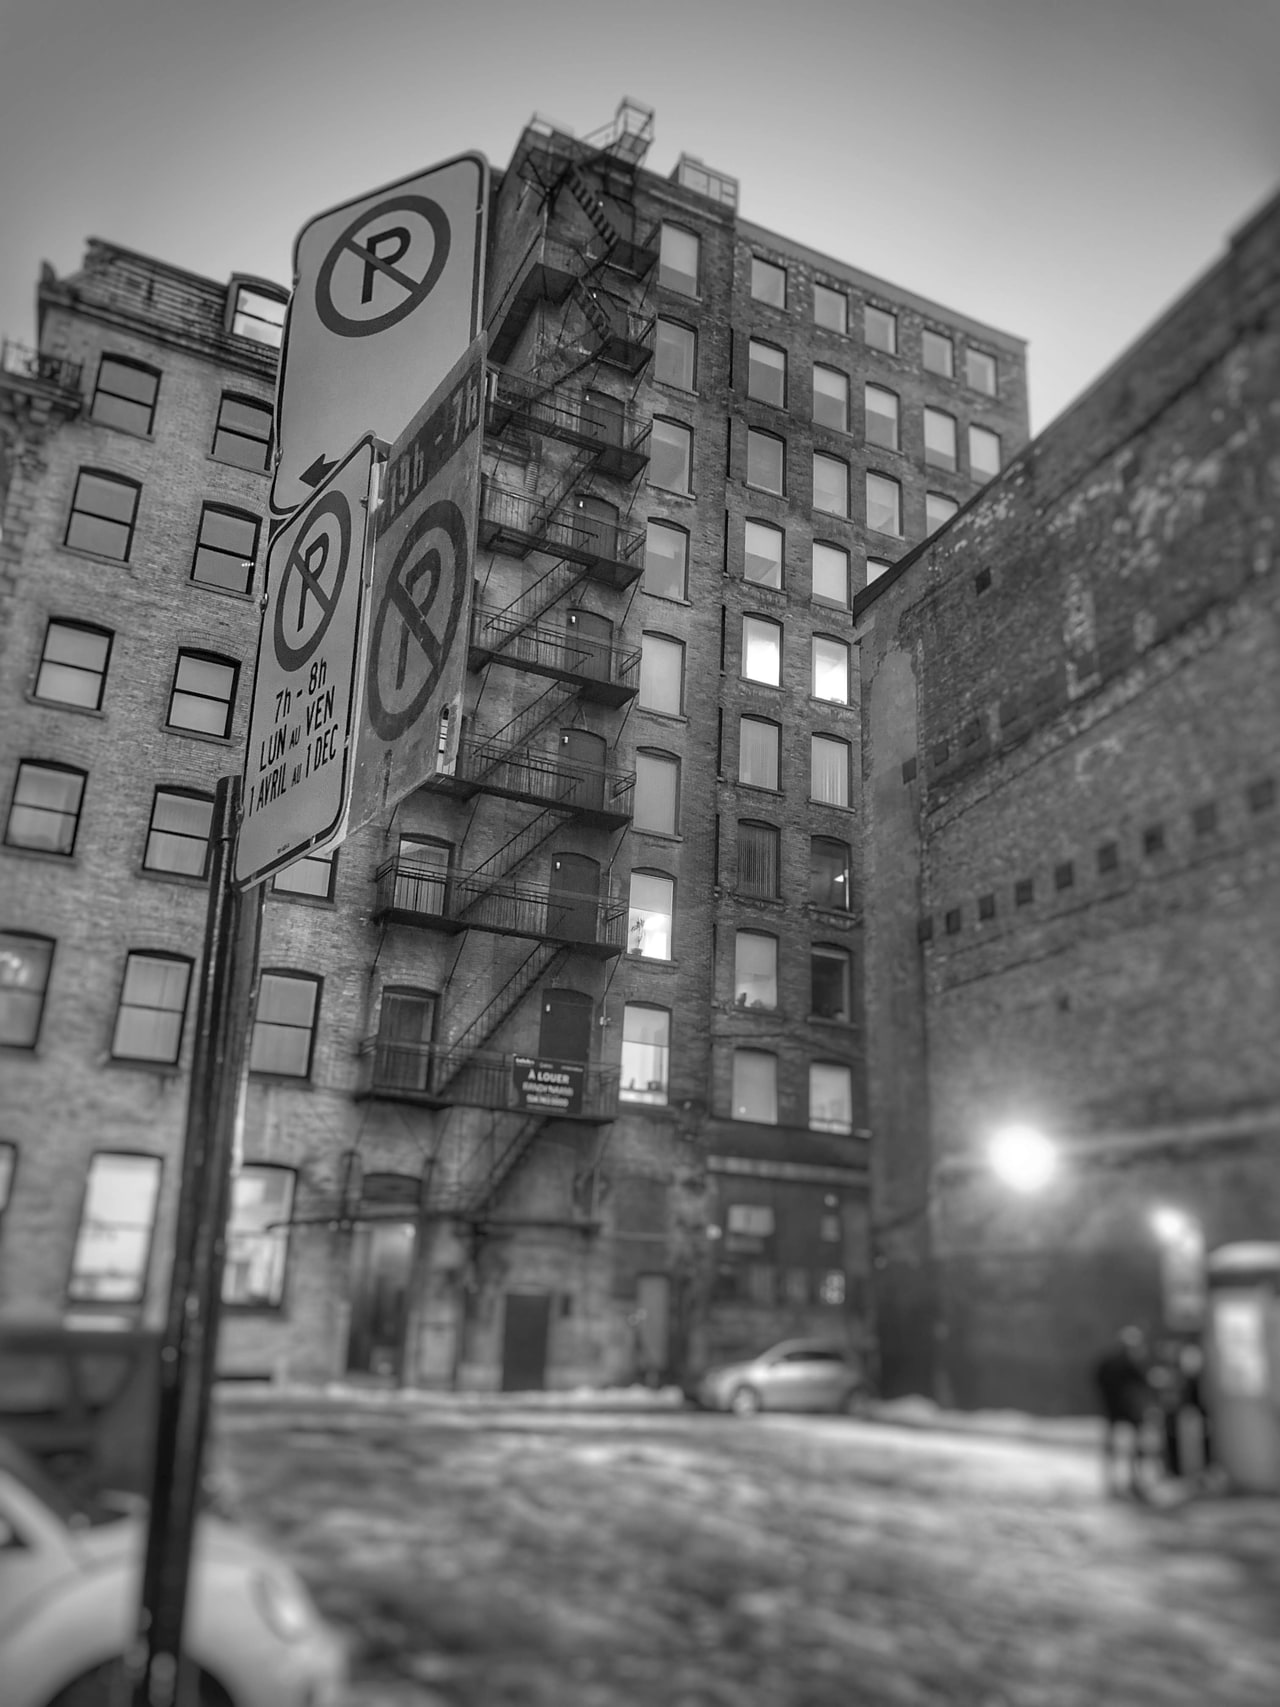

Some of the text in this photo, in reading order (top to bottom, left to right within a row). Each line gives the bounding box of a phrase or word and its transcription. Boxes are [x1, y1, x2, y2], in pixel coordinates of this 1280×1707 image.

[361, 227, 411, 304] P
[297, 532, 329, 632] P
[259, 685, 336, 772] LUN AU VEN
[275, 687, 292, 723] 7h
[308, 657, 328, 696] 8h
[249, 723, 339, 817] 1 AVRIL AU 1 DEC
[537, 1071, 570, 1085] LOUER
